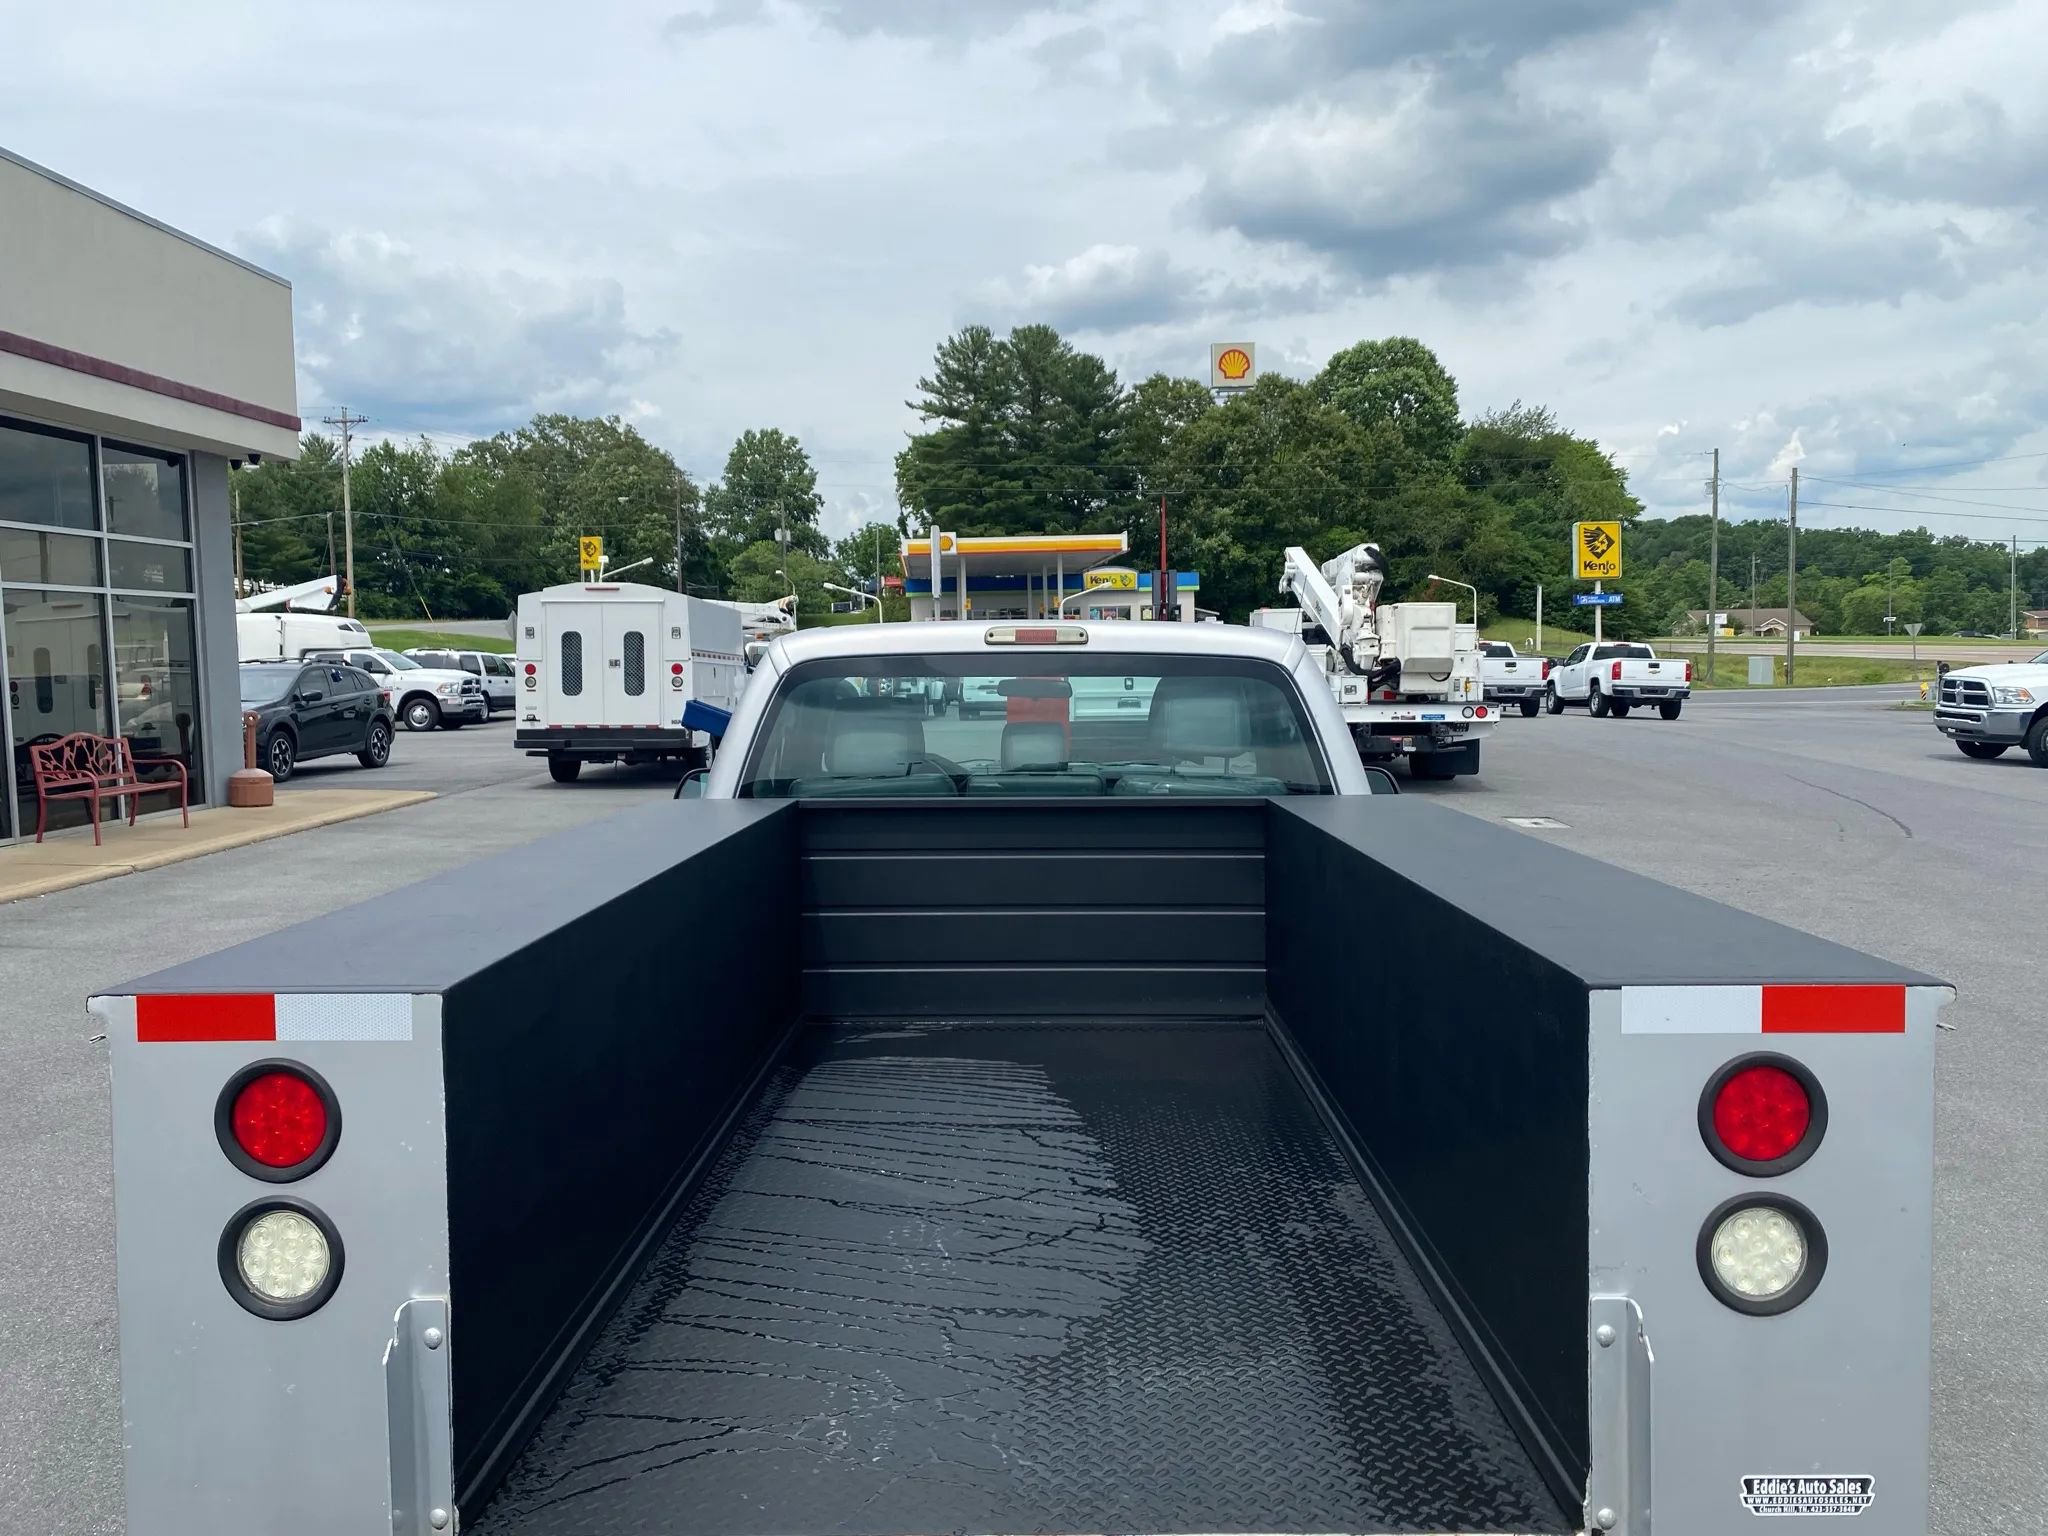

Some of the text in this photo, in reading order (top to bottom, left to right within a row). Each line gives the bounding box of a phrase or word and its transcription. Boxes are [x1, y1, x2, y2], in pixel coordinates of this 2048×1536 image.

[1584, 560, 1616, 575] Kenjo
[1753, 1479, 1862, 1494] Eddie's Auto Sales
[1747, 1496, 1868, 1504] WWW.EDDIESAUTOSALES.NET
